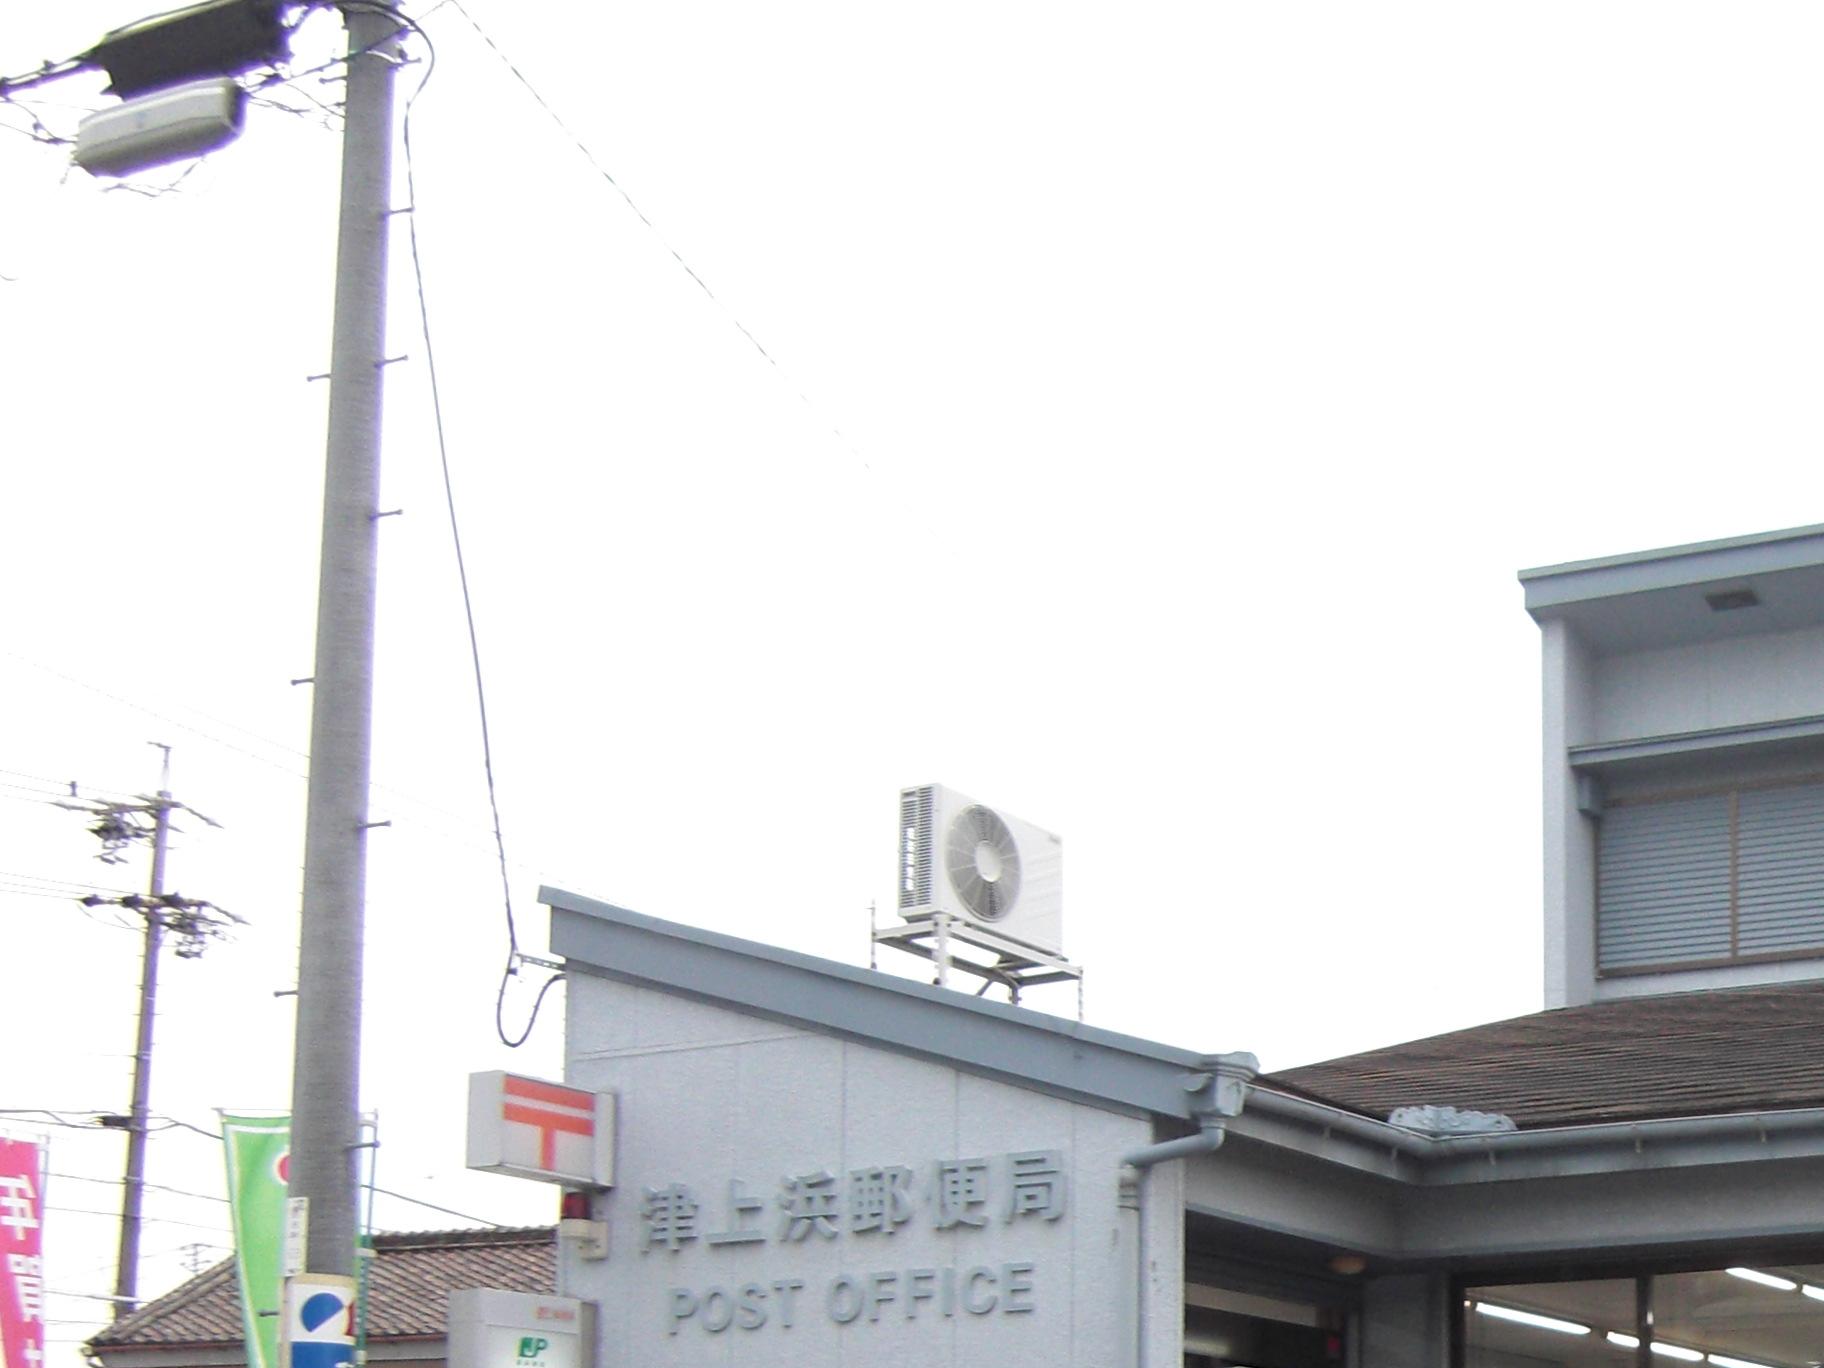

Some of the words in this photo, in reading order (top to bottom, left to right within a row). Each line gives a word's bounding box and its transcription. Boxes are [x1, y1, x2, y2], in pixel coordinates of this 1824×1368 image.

[638, 1149, 1069, 1254] 津上浜郵便局
[668, 1279, 804, 1335] POST
[826, 1261, 1036, 1325] OFFICE
